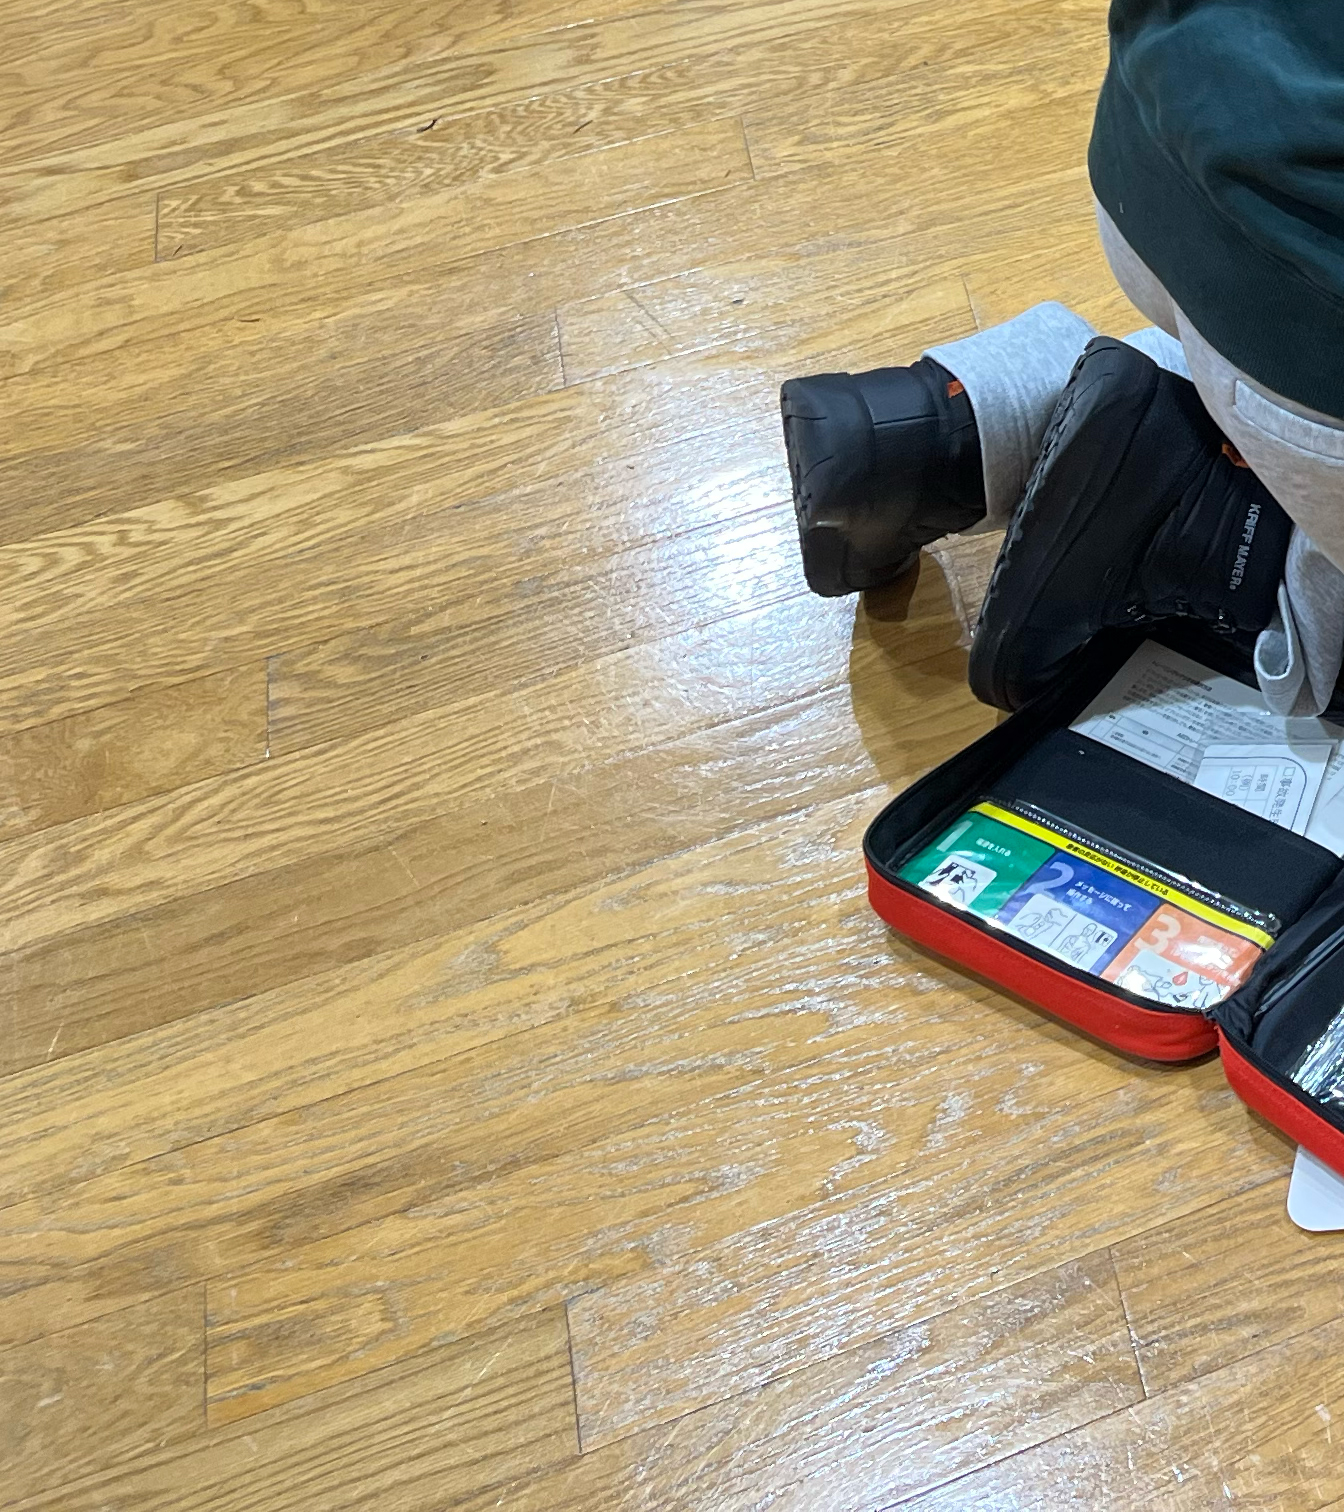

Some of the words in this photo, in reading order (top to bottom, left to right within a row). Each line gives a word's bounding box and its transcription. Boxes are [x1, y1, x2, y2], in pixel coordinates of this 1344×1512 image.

[1241, 503, 1262, 544] KRIFF
[1023, 861, 1074, 898] 2
[1134, 913, 1182, 954] 3
